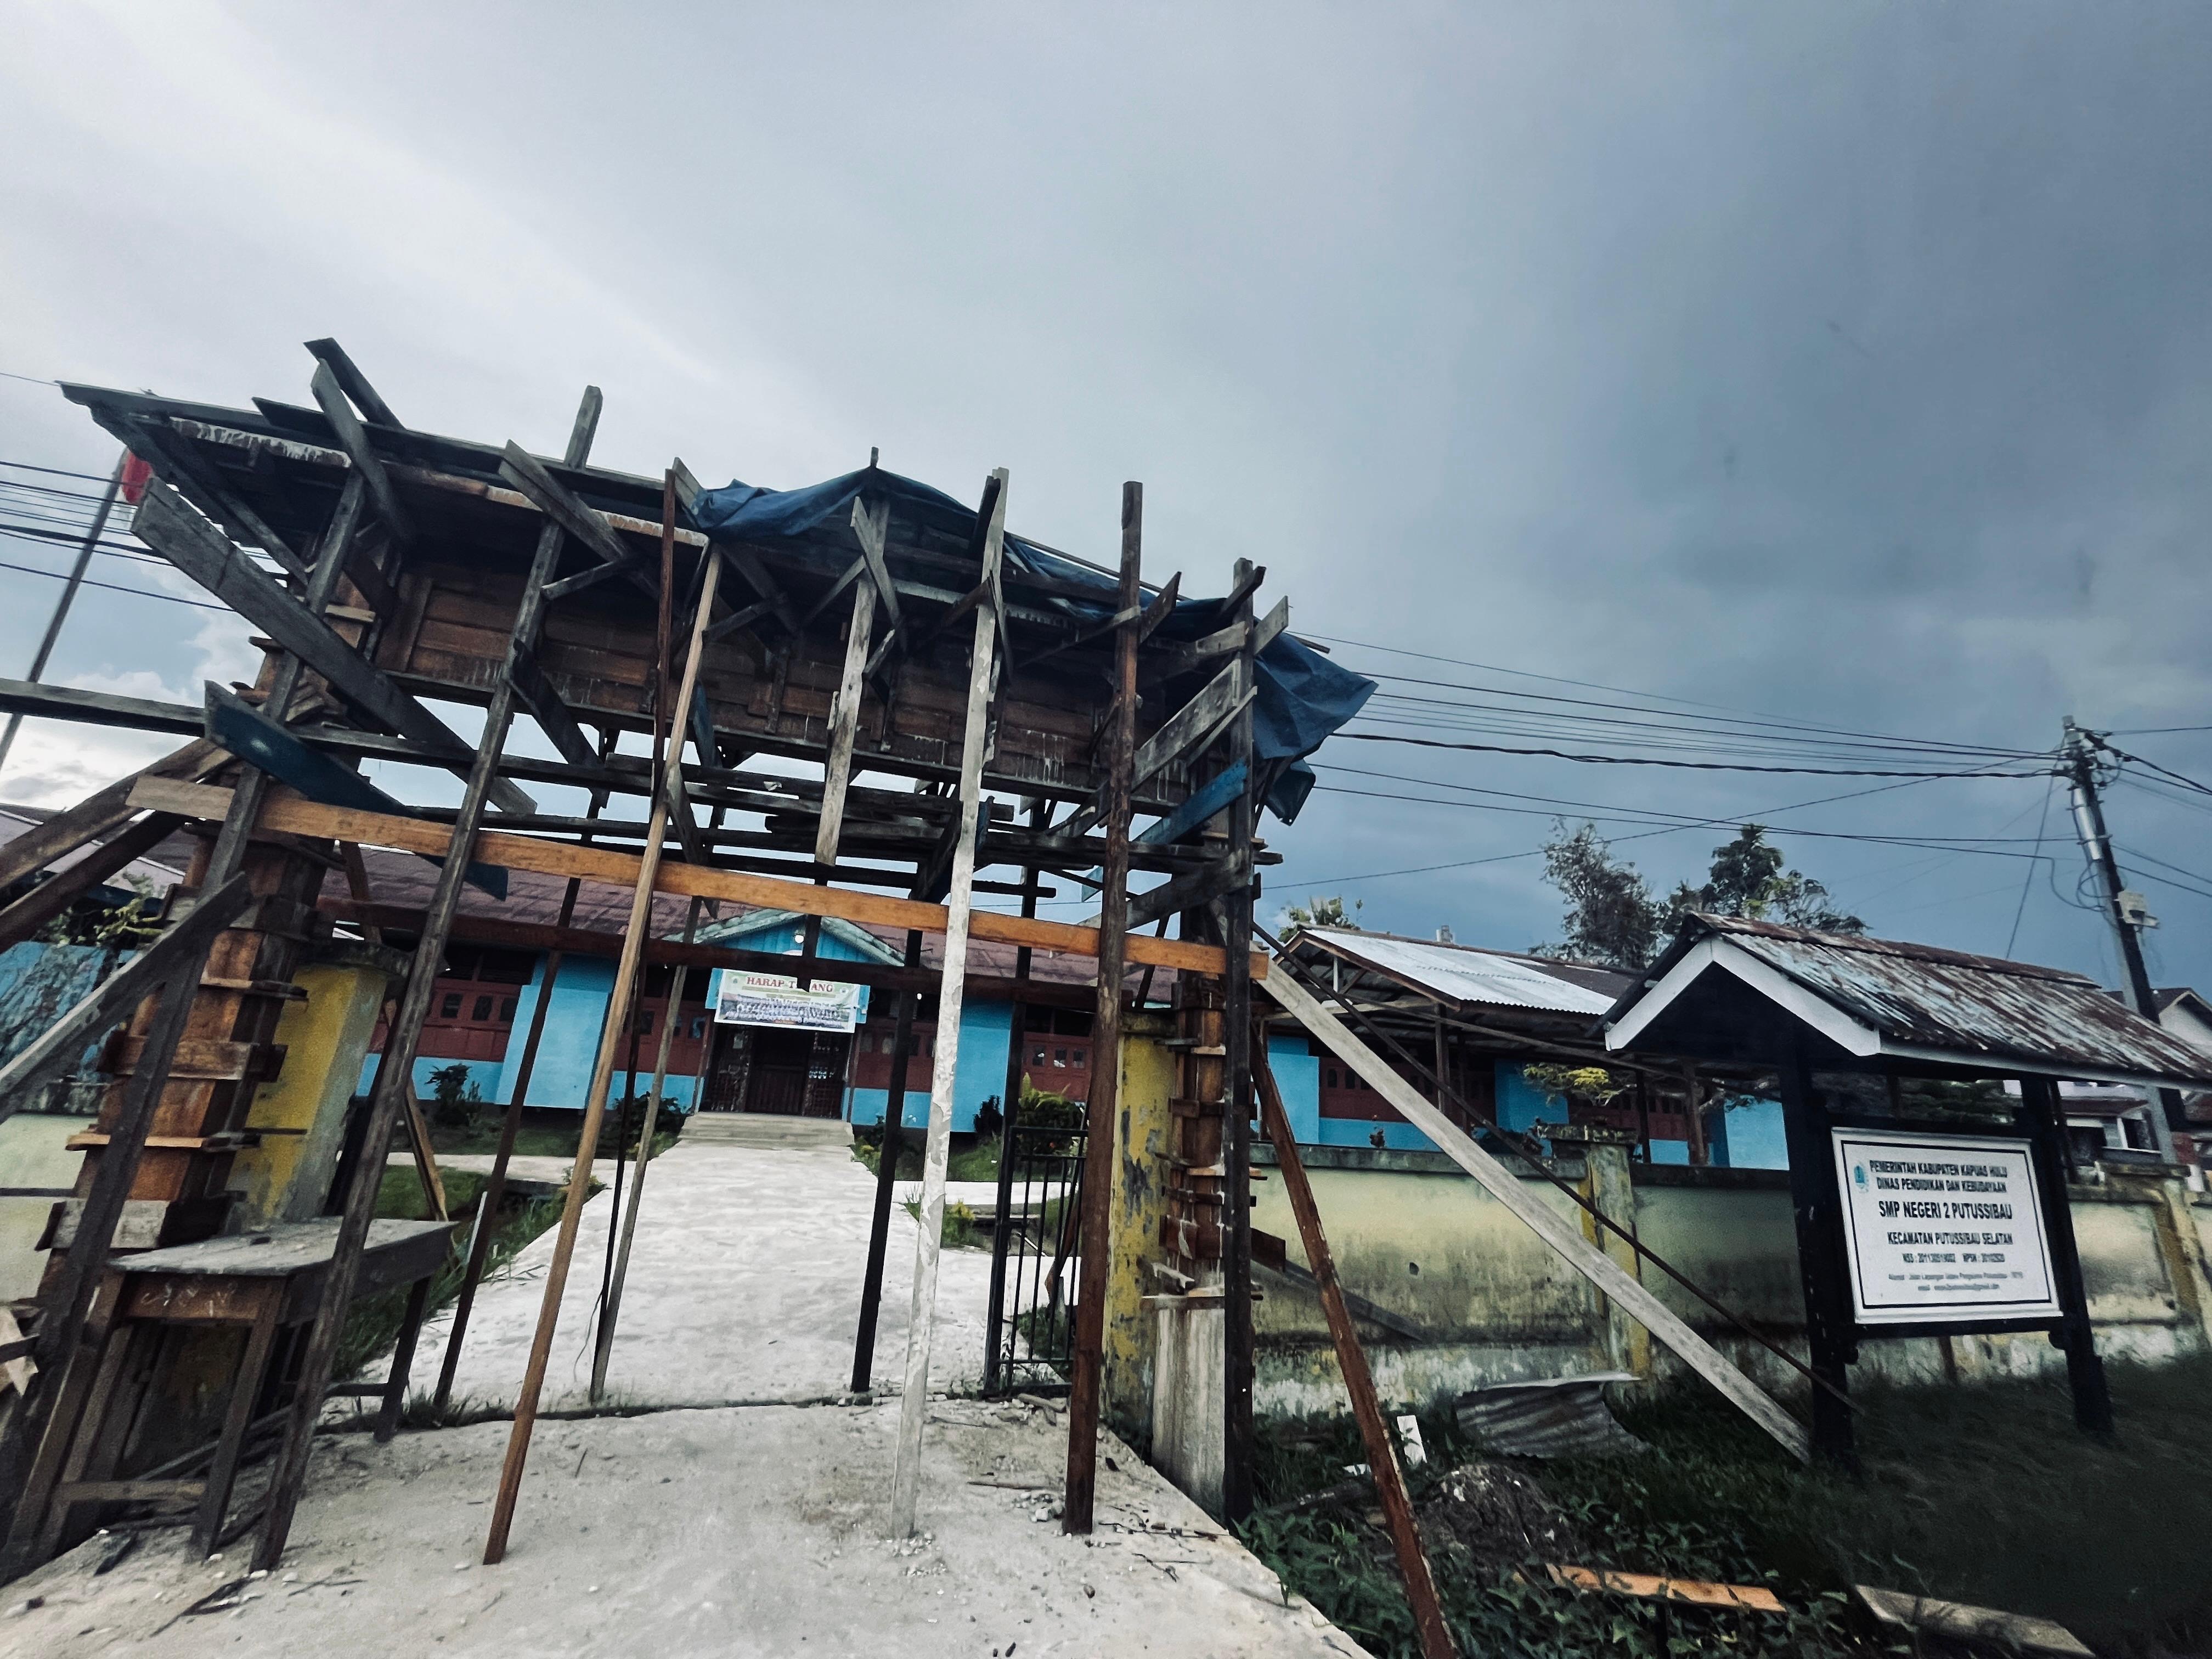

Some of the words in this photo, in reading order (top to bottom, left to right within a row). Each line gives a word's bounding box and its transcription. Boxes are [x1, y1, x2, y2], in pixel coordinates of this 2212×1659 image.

[747, 977, 785, 988] HARAP
[788, 981, 833, 992] TANG
[1877, 1177, 1900, 1189] DINAS
[1879, 1201, 1900, 1218] SMP
[1903, 1201, 1942, 1218] NEGERI
[1943, 1202, 1950, 1218] 2
[1951, 1202, 2012, 1219] PUTUSSIBAU
[1887, 1232, 1933, 1244] KECAMATAN
[1935, 1232, 1980, 1244] PUTUSSIBAU
[1982, 1232, 2013, 1245] SELATAN
